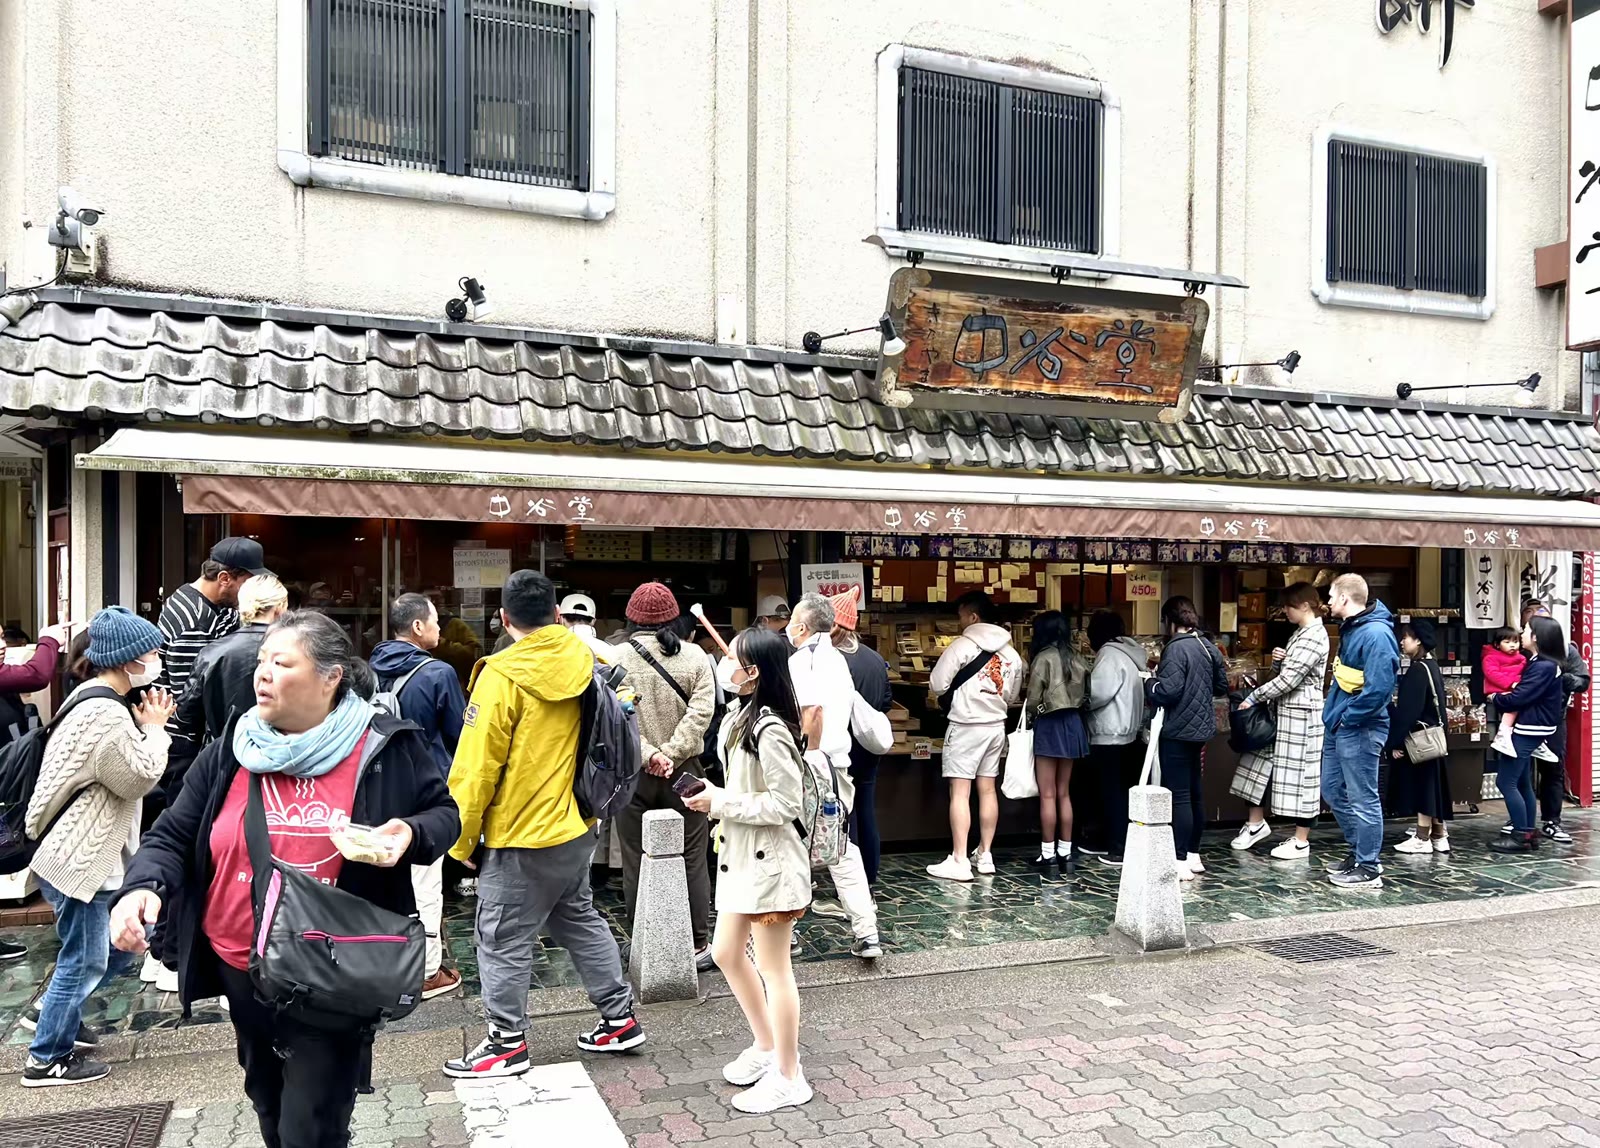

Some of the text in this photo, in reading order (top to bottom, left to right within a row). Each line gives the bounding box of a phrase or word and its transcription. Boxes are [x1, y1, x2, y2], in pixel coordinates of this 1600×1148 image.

[953, 308, 1155, 394] 中谷堂
[488, 493, 595, 522] 中谷堂
[884, 506, 969, 531] 中谷堂
[1200, 516, 1270, 539] 中谷堂
[1464, 527, 1521, 547] 中谷堂
[454, 559, 509, 567] DEMONSTRATION
[1131, 585, 1157, 596] 450円
[1475, 554, 1494, 622] 中谷堂
[1582, 551, 1594, 712] kish Ice Crm
[47, 1063, 68, 1078] N
